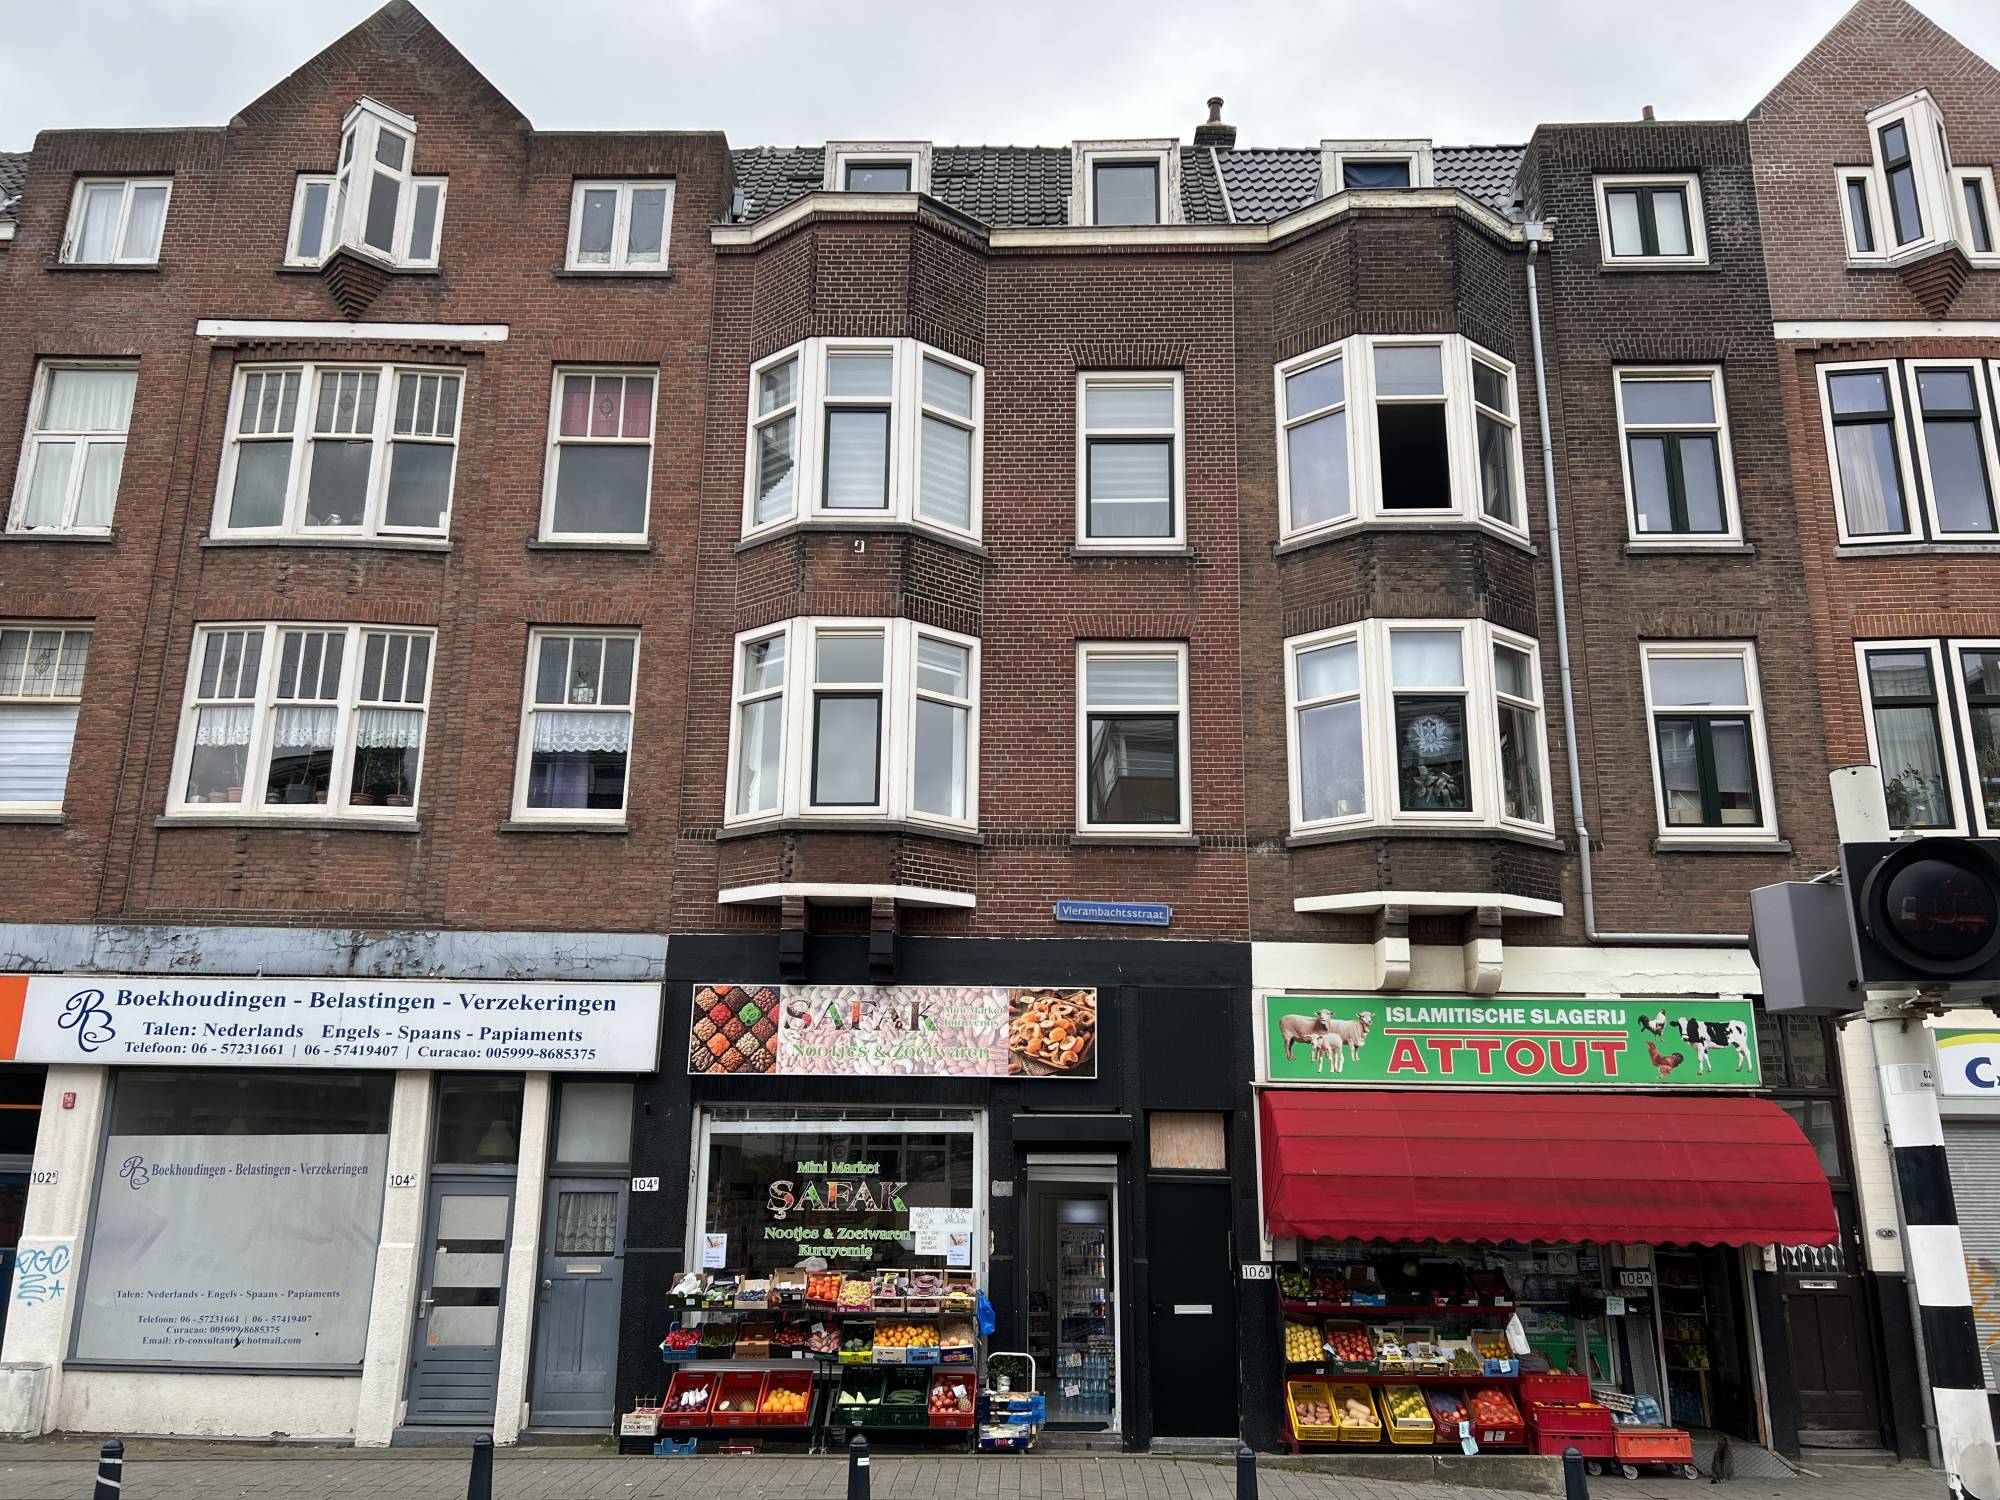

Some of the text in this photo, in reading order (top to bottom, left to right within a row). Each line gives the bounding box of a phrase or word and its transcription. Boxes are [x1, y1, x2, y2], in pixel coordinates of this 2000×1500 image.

[1062, 905, 1164, 920] Vierambachtsstraat
[116, 989, 287, 1012] Boekhoudingen
[309, 991, 435, 1014] Belastingen
[459, 993, 617, 1016] Verzekeringen
[1386, 1007, 1626, 1025] ISLAMITISCHE SLAGERIJ
[143, 1021, 197, 1037] Talen:
[202, 1022, 304, 1038] Nederlands
[322, 1025, 381, 1041] Engels
[398, 1026, 461, 1042] Spaans
[479, 1027, 583, 1044] Papiaments
[124, 1041, 187, 1054] Telefoon:
[191, 1043, 208, 1055] 06
[220, 1044, 284, 1056] 57231661
[304, 1045, 321, 1056] 06
[334, 1045, 398, 1057] 57419407
[417, 1045, 482, 1058] Curacao:
[485, 1047, 597, 1060] 005999-8685375
[874, 1045, 886, 1057] &
[1386, 1037, 1627, 1076] ATTOUT
[1965, 1057, 2000, 1088] C
[152, 1163, 226, 1179] Boekhoudingen
[235, 1164, 290, 1178] Belastingen
[300, 1162, 368, 1176] Verzekeringen
[797, 1161, 880, 1174] Mini Market
[764, 1227, 911, 1241] Nootjes & Zoetwaren
[799, 1245, 873, 1259] Kuruyemiş
[116, 1290, 144, 1298] Talen:
[147, 1290, 198, 1298] Nederlands
[207, 1290, 237, 1300] Engels
[246, 1290, 278, 1299] Spaans
[287, 1290, 340, 1299] Papiaments
[137, 1315, 178, 1323] Telefoon:
[180, 1315, 191, 1323] 06
[199, 1315, 239, 1323] 57231661
[252, 1315, 263, 1323] 06
[271, 1315, 312, 1323] 57419407
[166, 1326, 207, 1334] Curacao:
[142, 1337, 171, 1345] Email:
